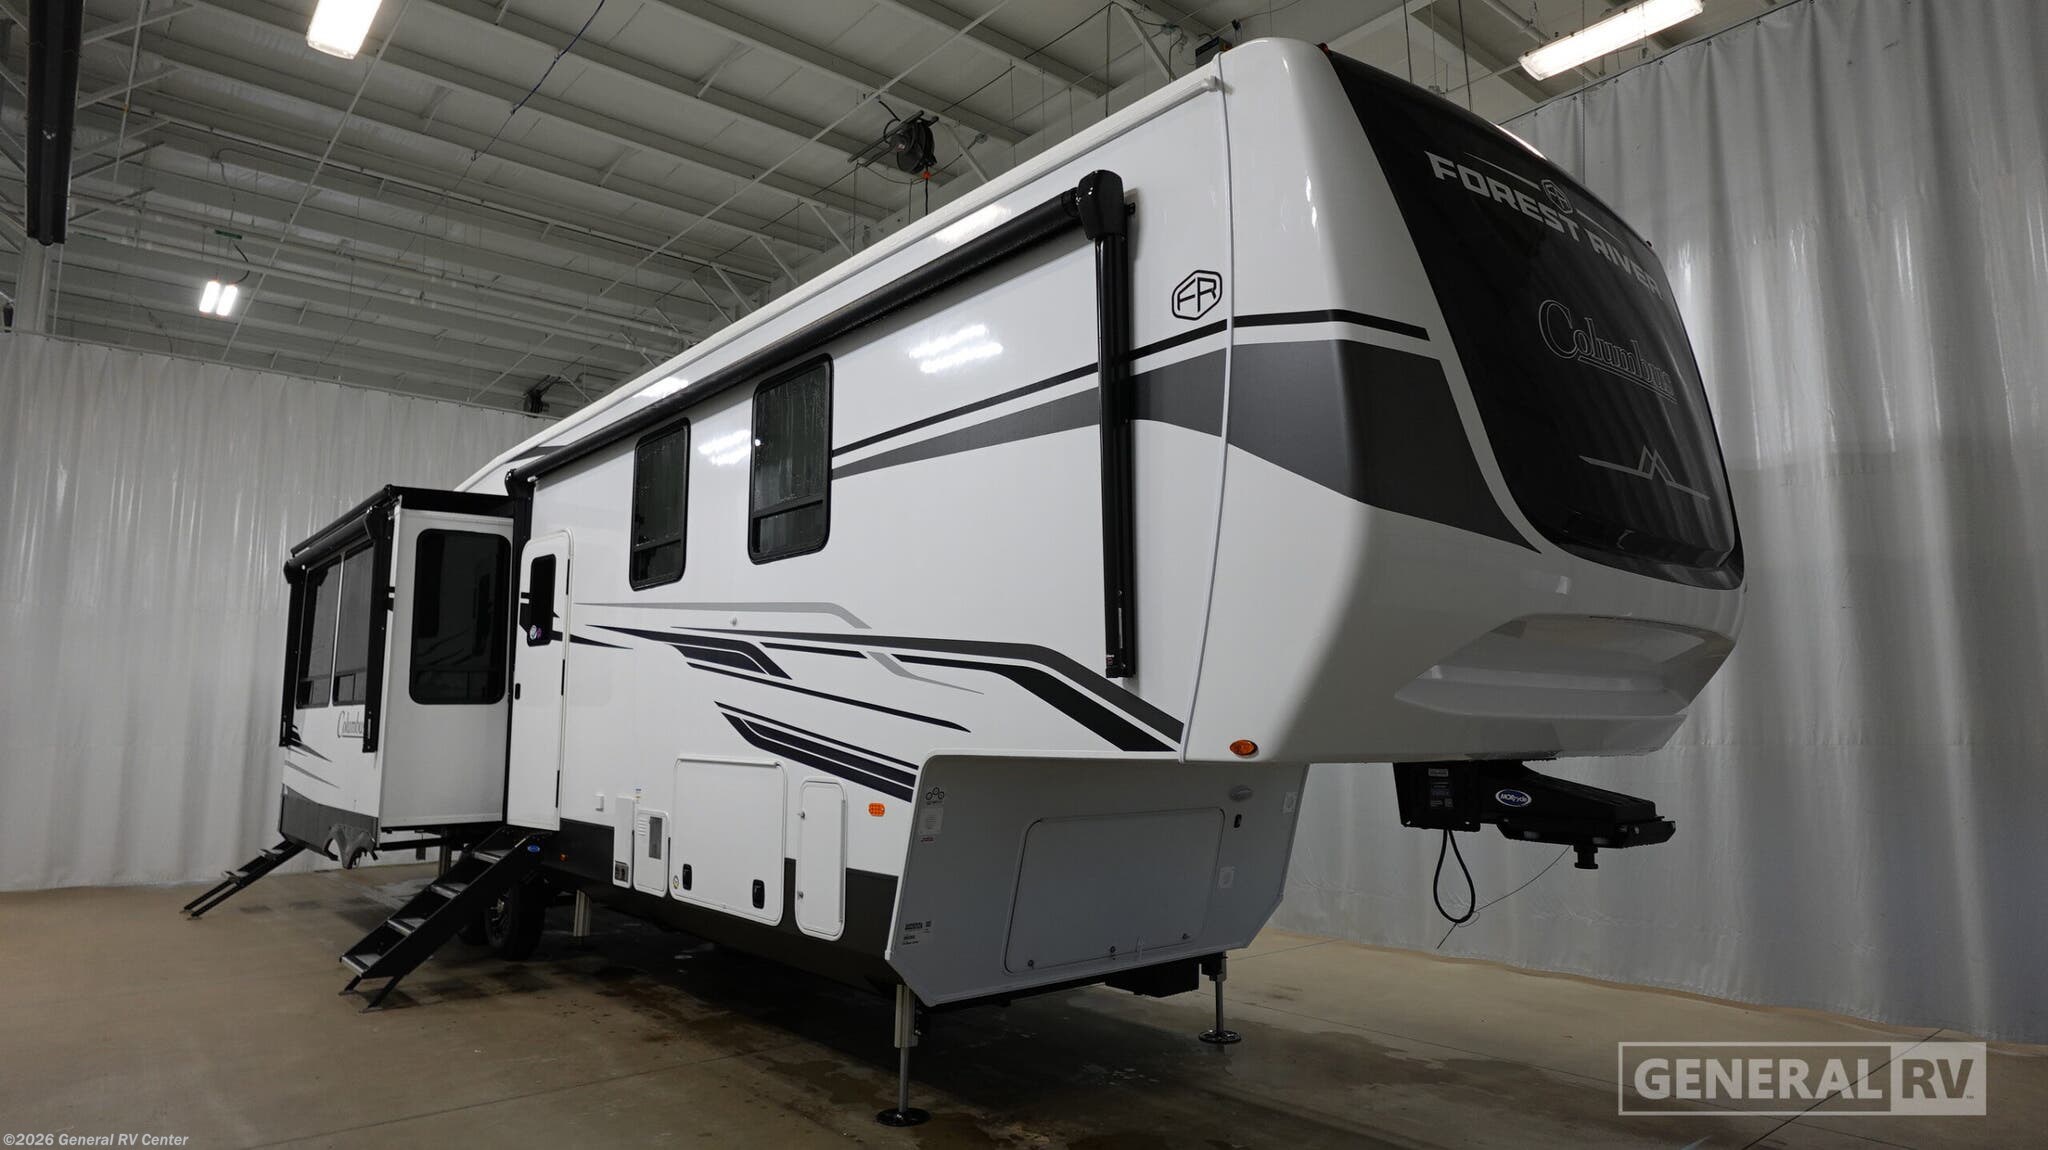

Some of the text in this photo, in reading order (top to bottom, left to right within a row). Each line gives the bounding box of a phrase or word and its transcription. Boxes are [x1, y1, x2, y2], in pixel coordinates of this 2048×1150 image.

[1424, 151, 1663, 298] FOREST RIVER
[1538, 300, 1674, 397] Columbus
